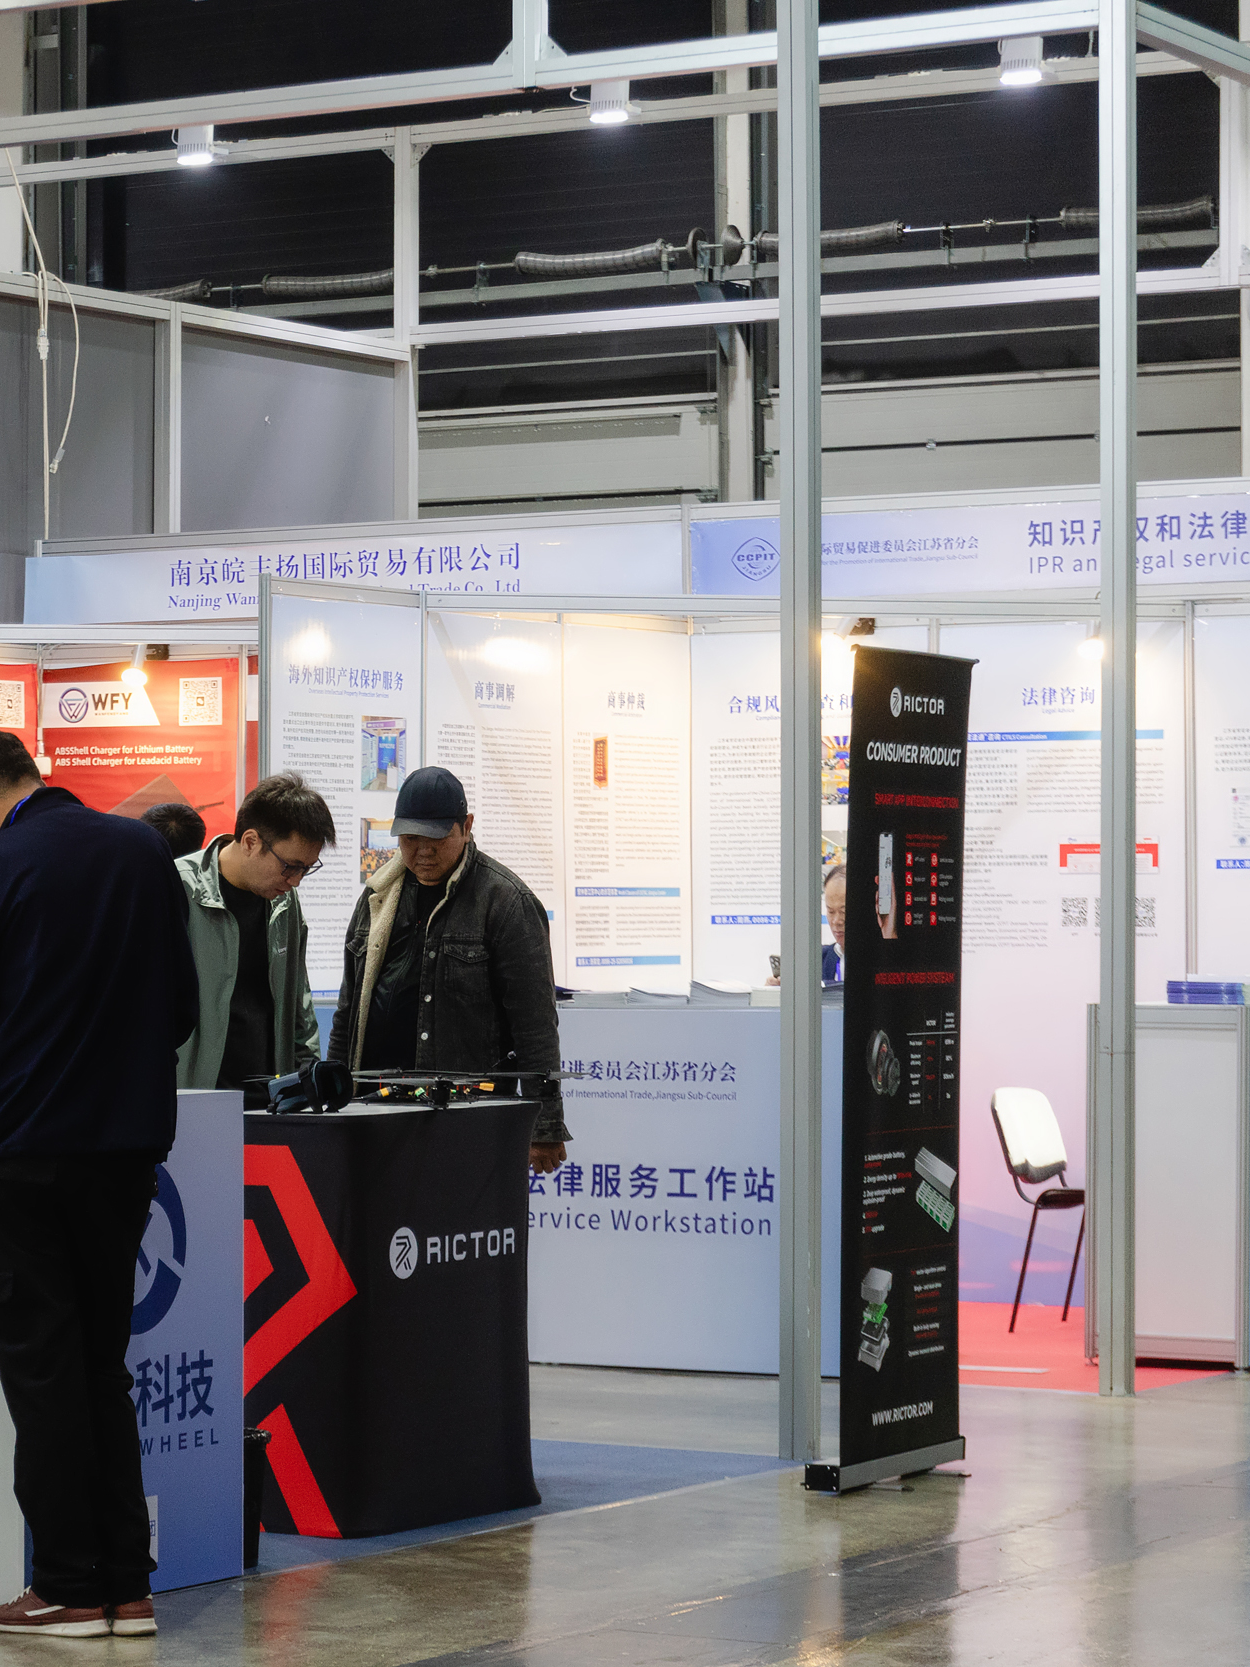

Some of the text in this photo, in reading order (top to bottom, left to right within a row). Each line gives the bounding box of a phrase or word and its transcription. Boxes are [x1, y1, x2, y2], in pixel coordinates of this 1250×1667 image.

[168, 541, 520, 588] 南京皖丰扬国际贸易有限公司
[737, 552, 776, 562] CCPIT
[1029, 556, 1064, 574] IPR
[1072, 557, 1098, 572] an
[1136, 549, 1174, 575] egal
[168, 594, 222, 612] Nanjing
[226, 592, 259, 606] Wan
[288, 664, 404, 691] 海外知识产权保护服务
[92, 692, 132, 711] WFY
[474, 680, 516, 703] 商事调解
[1021, 686, 1095, 707] 法律咨询
[903, 695, 945, 715] RICTOR
[55, 755, 202, 768] ABS Shell Charger for Leadacid Battery
[90, 745, 121, 757] Charger
[122, 745, 133, 755] for
[134, 745, 164, 755] Lithium
[165, 744, 194, 755] Battery
[866, 741, 962, 767] CONSUMER PRODUCT
[565, 1089, 574, 1098] of
[575, 1089, 628, 1099] International
[687, 1090, 737, 1101] Sub-Council
[528, 1207, 772, 1236] ervice Workstation
[426, 1227, 515, 1265] RICTOR
[135, 1349, 214, 1427] 科技
[871, 1400, 934, 1427] WWW.RICTOR.COM
